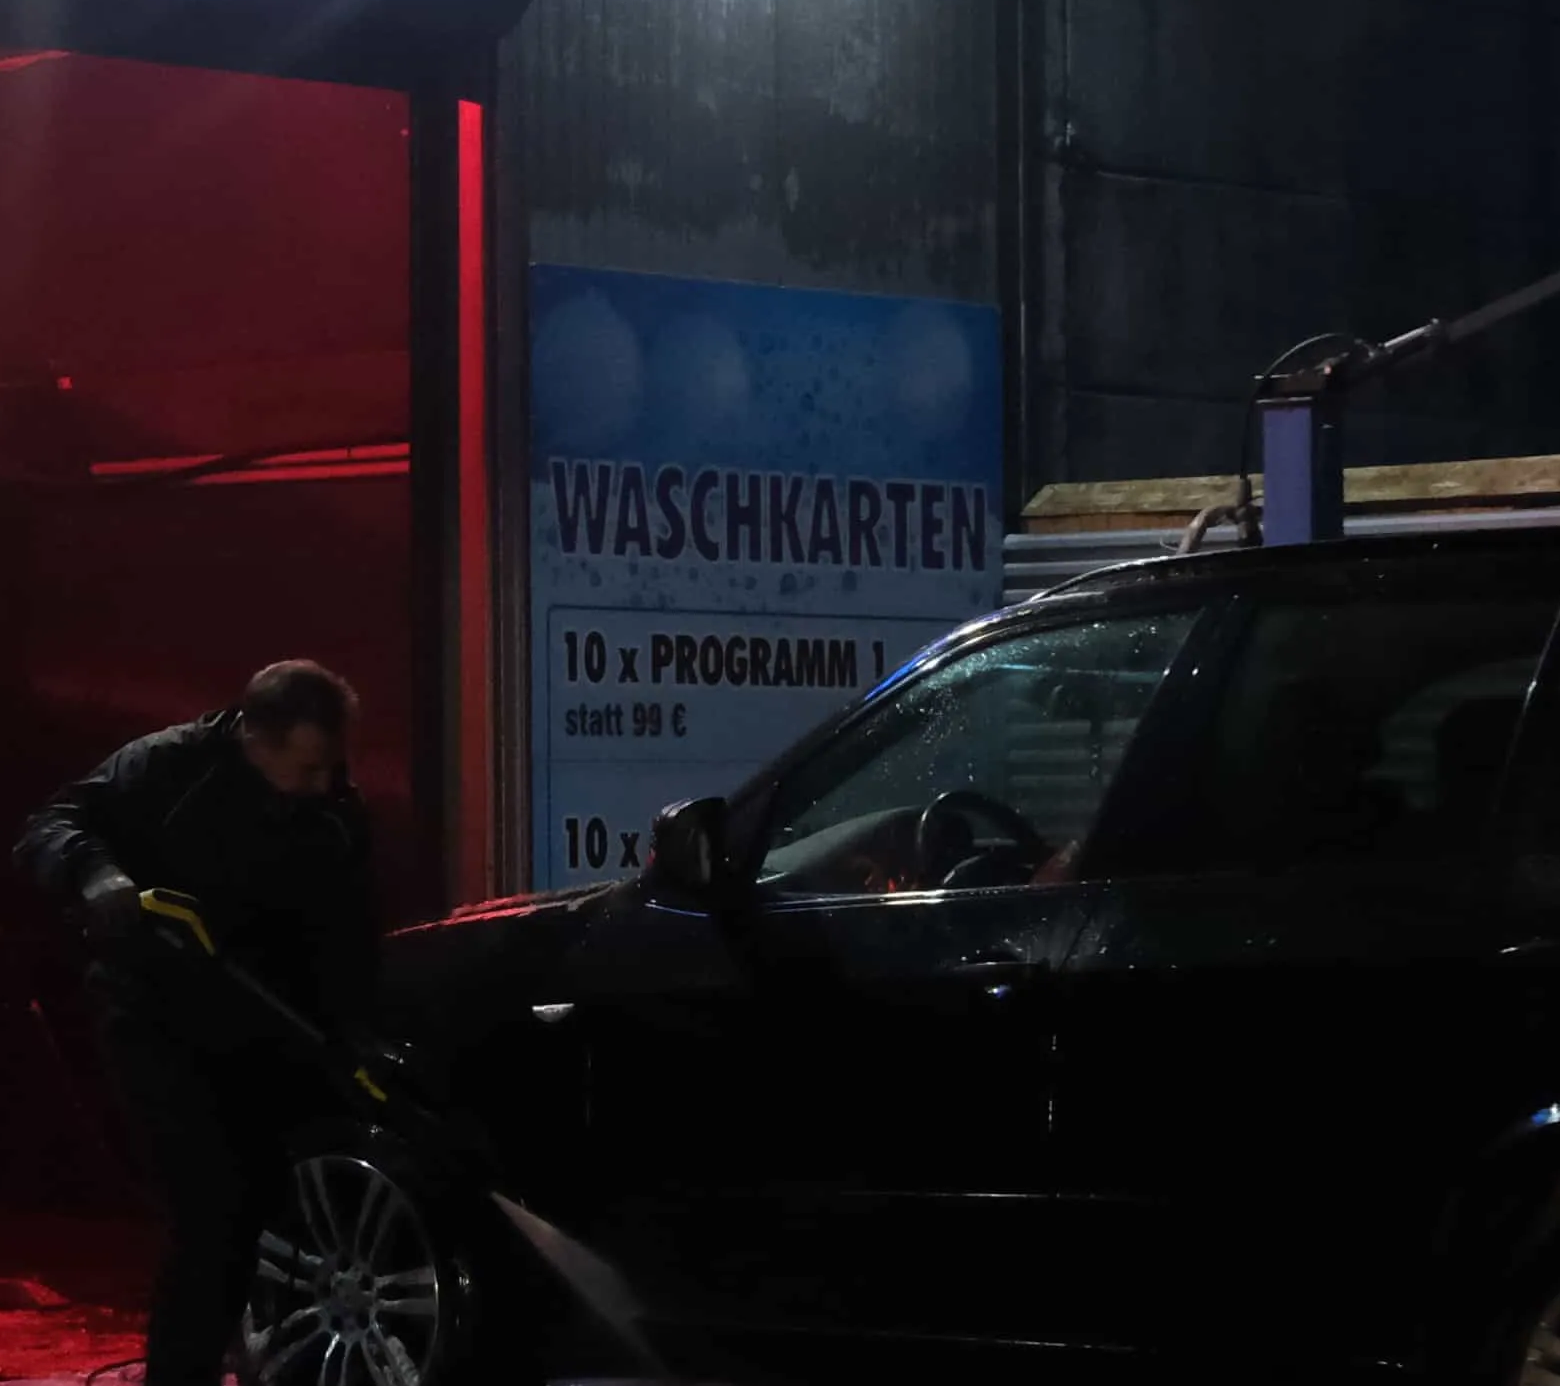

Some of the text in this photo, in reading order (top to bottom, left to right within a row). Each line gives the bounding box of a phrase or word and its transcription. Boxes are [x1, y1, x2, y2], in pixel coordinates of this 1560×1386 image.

[550, 460, 987, 571] WASCHKARTEN
[564, 630, 606, 683] 10
[618, 647, 640, 683] x
[651, 633, 858, 688] PROGRAMM
[564, 702, 687, 738] statt 99 €
[565, 817, 641, 869] 10 x
